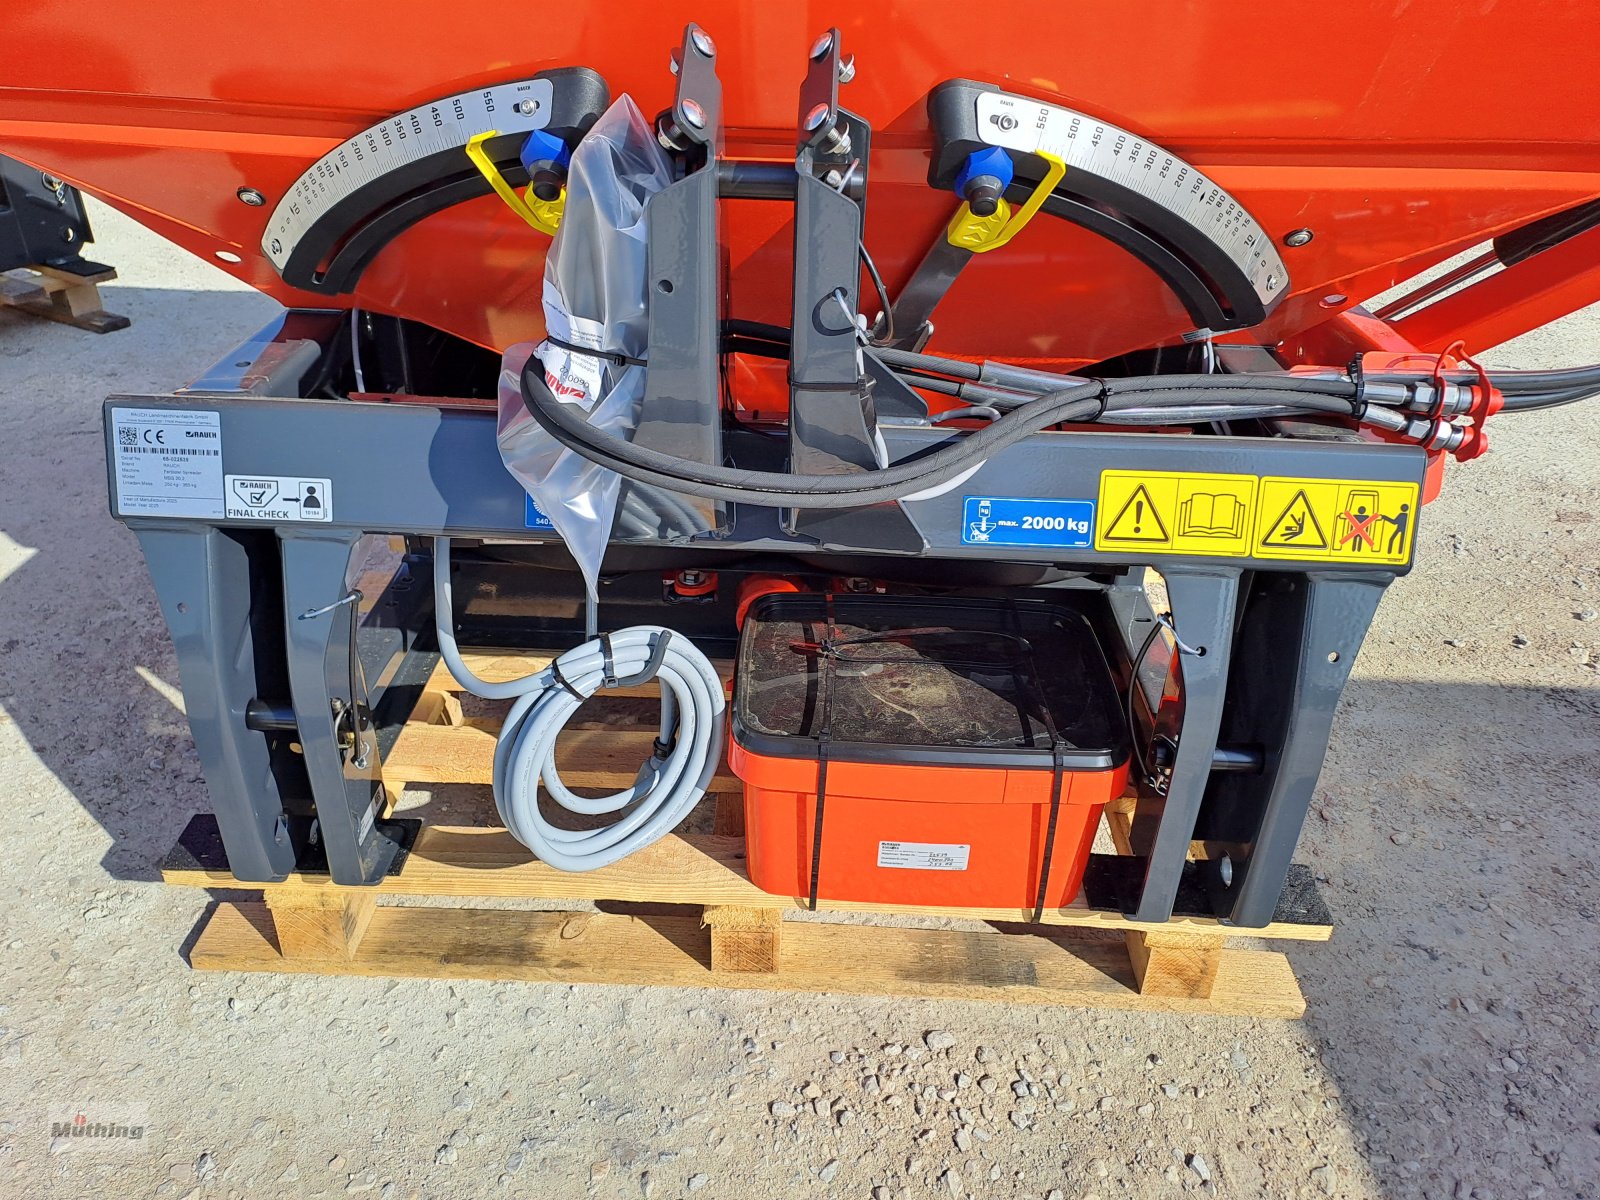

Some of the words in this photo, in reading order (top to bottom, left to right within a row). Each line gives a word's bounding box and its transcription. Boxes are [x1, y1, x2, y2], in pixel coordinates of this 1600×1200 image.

[452, 99, 464, 120] 500
[484, 92, 495, 112] 550
[410, 114, 422, 134] 400
[431, 106, 442, 126] 450
[1036, 108, 1049, 130] 550
[380, 126, 392, 146] 300
[394, 120, 406, 140] 350
[1068, 118, 1080, 139] 500
[1091, 126, 1104, 147] 450
[351, 141, 364, 160] 200
[365, 133, 378, 152] 250
[1113, 135, 1126, 156] 400
[338, 150, 348, 168] 150
[1129, 142, 1142, 163] 350
[1144, 150, 1157, 171] 300
[316, 166, 326, 178] 80
[324, 160, 334, 178] 100
[1159, 158, 1173, 178] 250
[301, 180, 310, 192] 30
[308, 172, 317, 185] 50
[1174, 168, 1188, 188] 200
[1190, 178, 1204, 194] 150
[295, 186, 302, 197] 15
[1206, 189, 1219, 206] 100
[291, 202, 300, 214] 10
[1216, 195, 1226, 208] 80
[1226, 203, 1235, 216] 50
[1234, 210, 1243, 223] 30
[1242, 218, 1251, 228] 15
[1244, 234, 1254, 246] 10
[228, 508, 256, 518] FINAL
[258, 510, 289, 519] CHECK
[1022, 516, 1065, 530] 2000
[1067, 518, 1089, 534] kg
